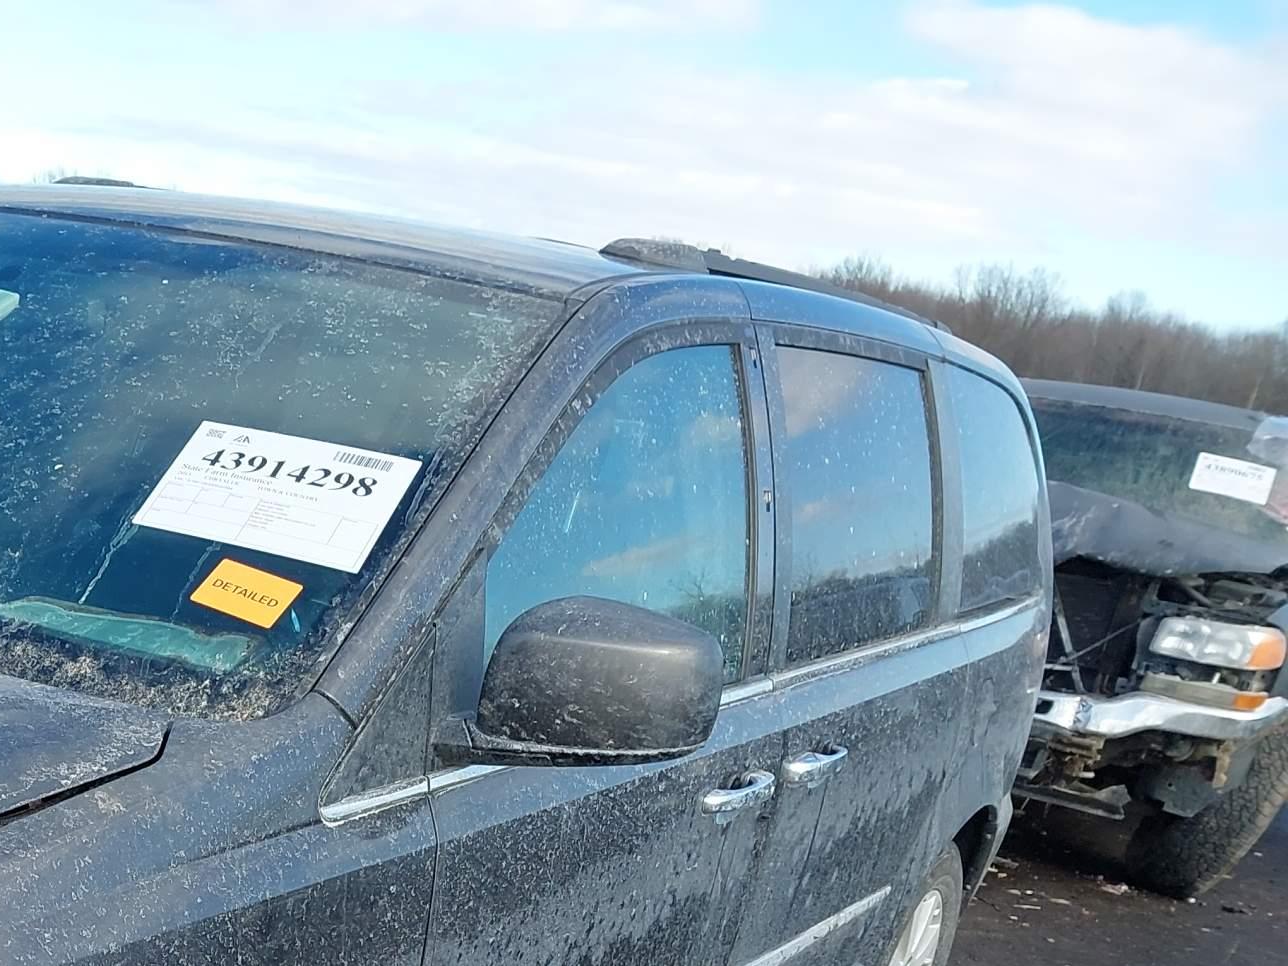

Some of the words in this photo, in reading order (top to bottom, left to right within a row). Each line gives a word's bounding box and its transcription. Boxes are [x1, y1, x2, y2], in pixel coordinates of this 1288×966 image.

[182, 463, 203, 473] State
[204, 467, 229, 478] Farm
[230, 471, 274, 486] Insurance
[202, 449, 378, 497] 43914298
[211, 577, 280, 610] DETAILED
